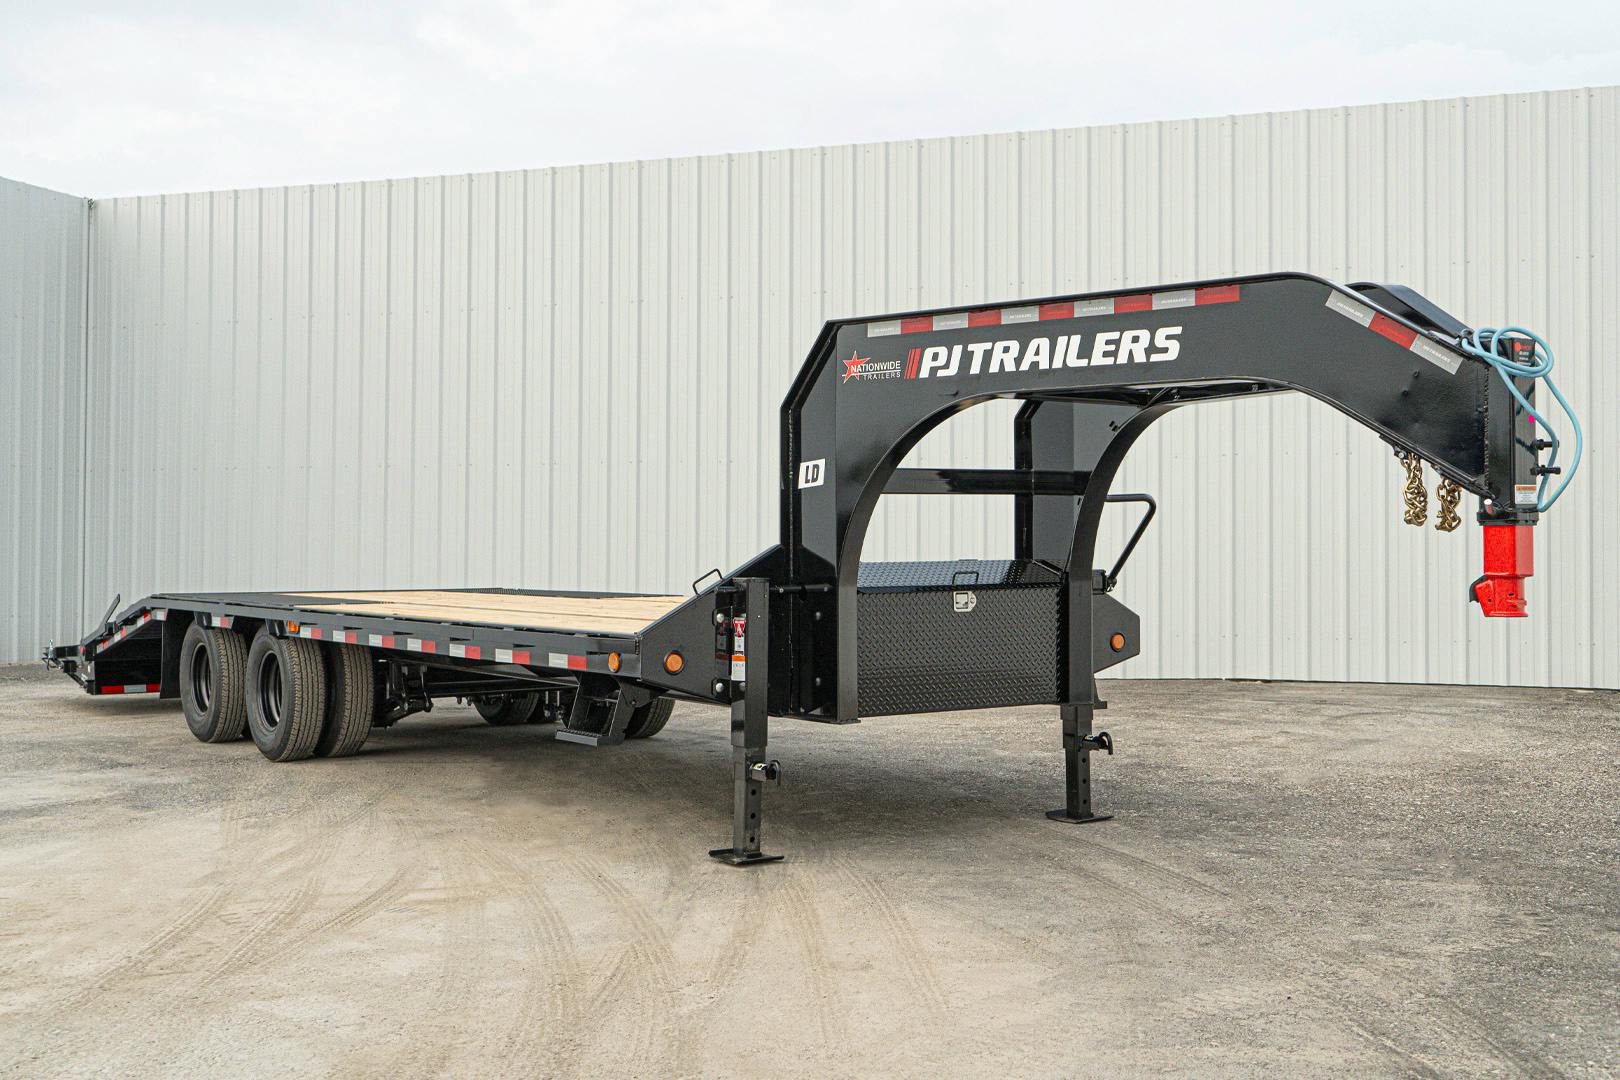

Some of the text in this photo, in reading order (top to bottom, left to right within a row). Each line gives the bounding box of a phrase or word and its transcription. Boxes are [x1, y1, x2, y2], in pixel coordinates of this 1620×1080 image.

[919, 326, 1183, 379] PJ TRAILERS
[850, 360, 901, 373] NATIONWIDE
[863, 371, 901, 381] TRAILERS
[804, 463, 820, 484] LD
